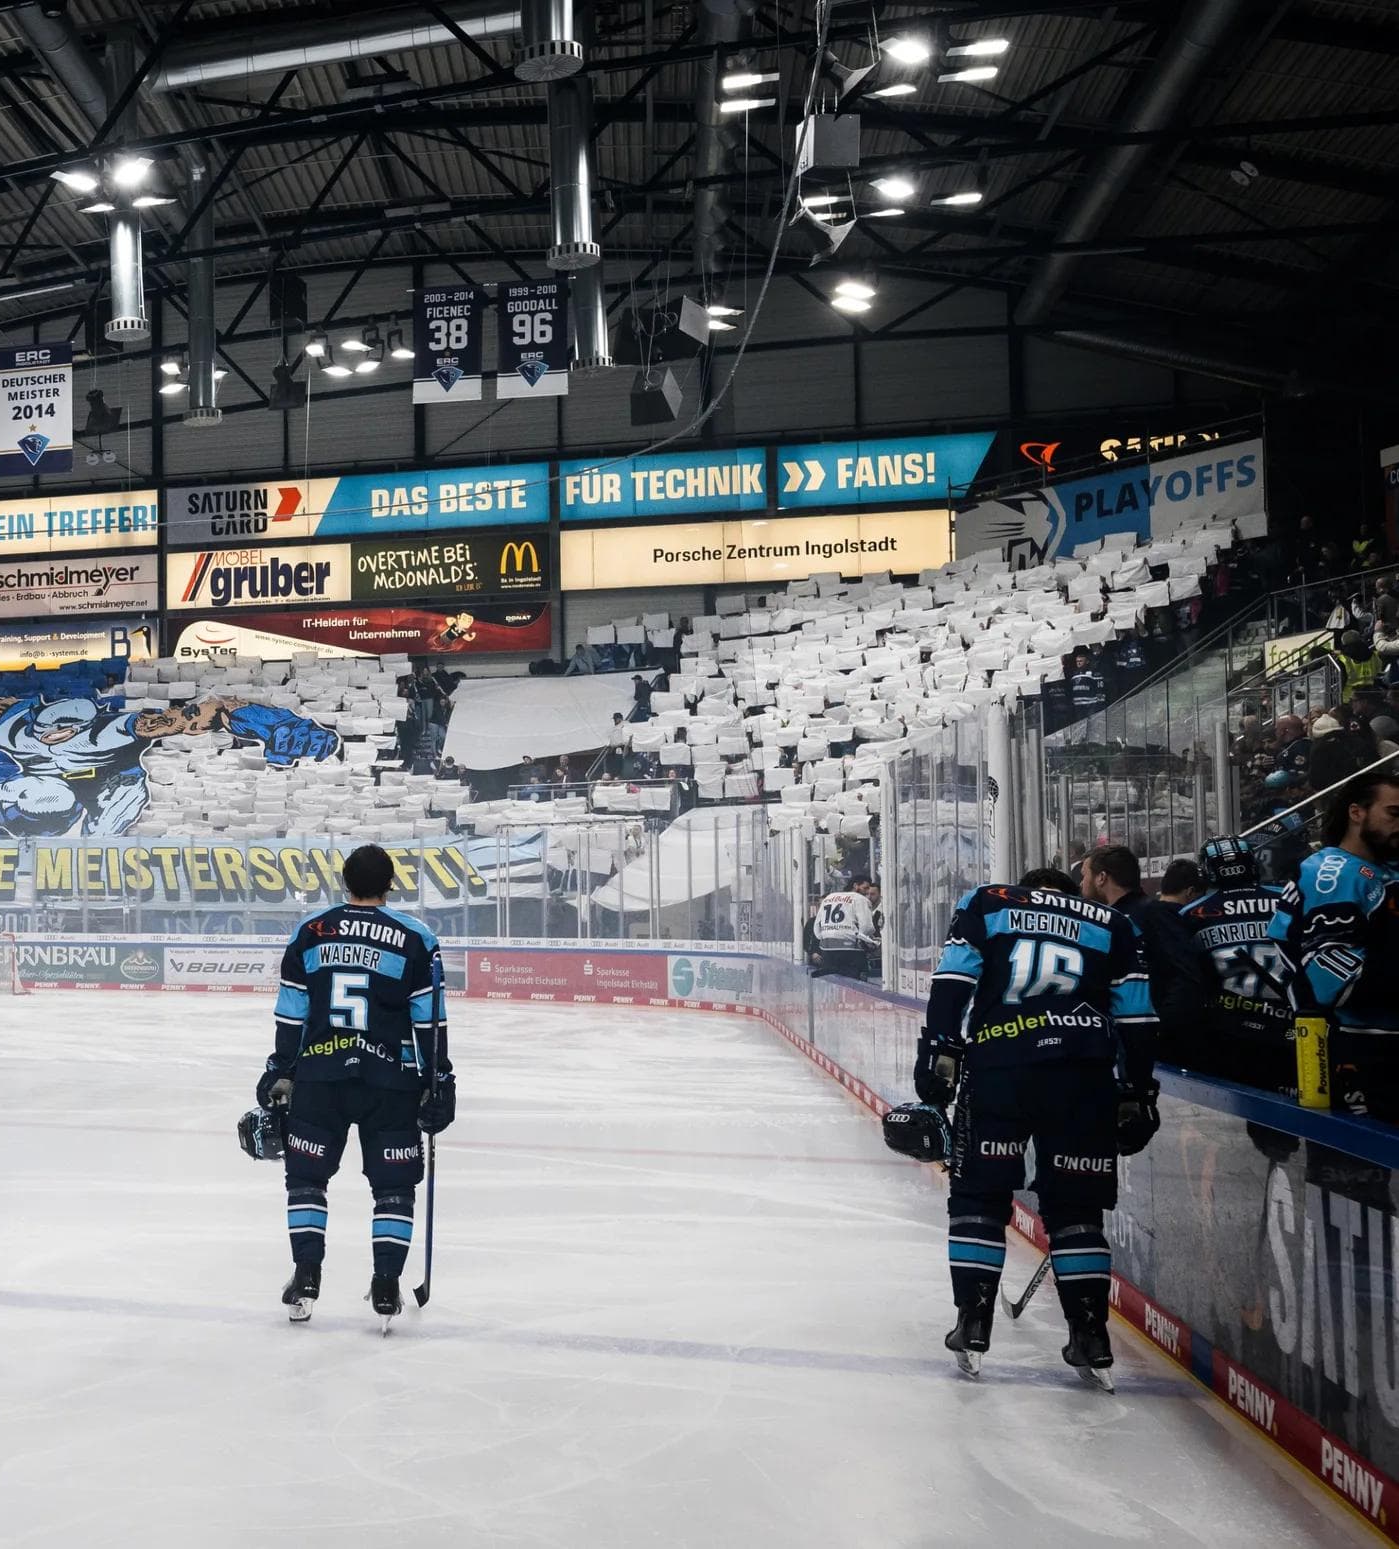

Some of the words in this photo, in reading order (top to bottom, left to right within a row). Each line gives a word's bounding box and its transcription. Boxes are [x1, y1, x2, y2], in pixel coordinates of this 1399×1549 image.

[426, 305, 471, 319] FICENEC
[507, 299, 558, 313] GOODALL
[429, 318, 468, 351] 38
[512, 312, 553, 346] 96
[15, 350, 50, 362] ERC
[436, 357, 459, 366] ERC
[521, 351, 544, 359] ERC
[2, 373, 66, 388] DEUTSCHER
[7, 388, 60, 401] MEISTER
[12, 403, 56, 421] 2014
[837, 452, 936, 489] FANS!
[566, 469, 621, 505] FÜR
[631, 463, 764, 501] TECHNIK
[1074, 455, 1256, 522] PLAYOFFS
[188, 488, 268, 515] SATURN
[372, 486, 428, 518] DAS
[439, 479, 527, 514] BESTE
[44, 505, 157, 537] TREFFER!
[211, 512, 268, 536] CARD
[212, 549, 267, 566] MÖBEL
[653, 546, 722, 563] Porsche
[726, 542, 800, 560] Zentrum
[805, 537, 898, 558] Ingolstadt
[210, 558, 331, 606] gruber
[17, 593, 46, 601] Erdbau
[52, 589, 89, 599] Abbruch
[303, 618, 350, 628] IT-Helden
[353, 617, 368, 626] für
[349, 629, 421, 640] Unternehmen
[24, 633, 51, 642] Support
[60, 632, 105, 642] Development
[181, 646, 238, 657] SysTec
[37, 844, 486, 892] MEISTERSCHFT!
[824, 904, 845, 923] 16
[1031, 891, 1111, 925] SATURN
[339, 919, 406, 948] SATURN
[1009, 909, 1081, 941] MCGINN
[320, 945, 380, 969] WAGNER
[495, 964, 533, 974] Sparkasse
[1313, 948, 1364, 982] 10
[495, 975, 534, 985] Ingolstadt
[536, 975, 567, 985] Eichstätt
[596, 967, 630, 977] Sparkasse
[596, 979, 630, 989] Ingolstadt
[329, 972, 369, 1031] 5
[976, 1010, 1102, 1044] zieglerhaus
[1318, 1033, 1328, 1095] Powerbar
[288, 1133, 326, 1157] CINQUE
[384, 1146, 419, 1160] CINQUE
[1054, 1155, 1112, 1173] CINQUE
[1145, 1302, 1181, 1358] PENNY.
[1228, 1366, 1279, 1436] PENNY.
[1321, 1436, 1388, 1526] PENNY.
